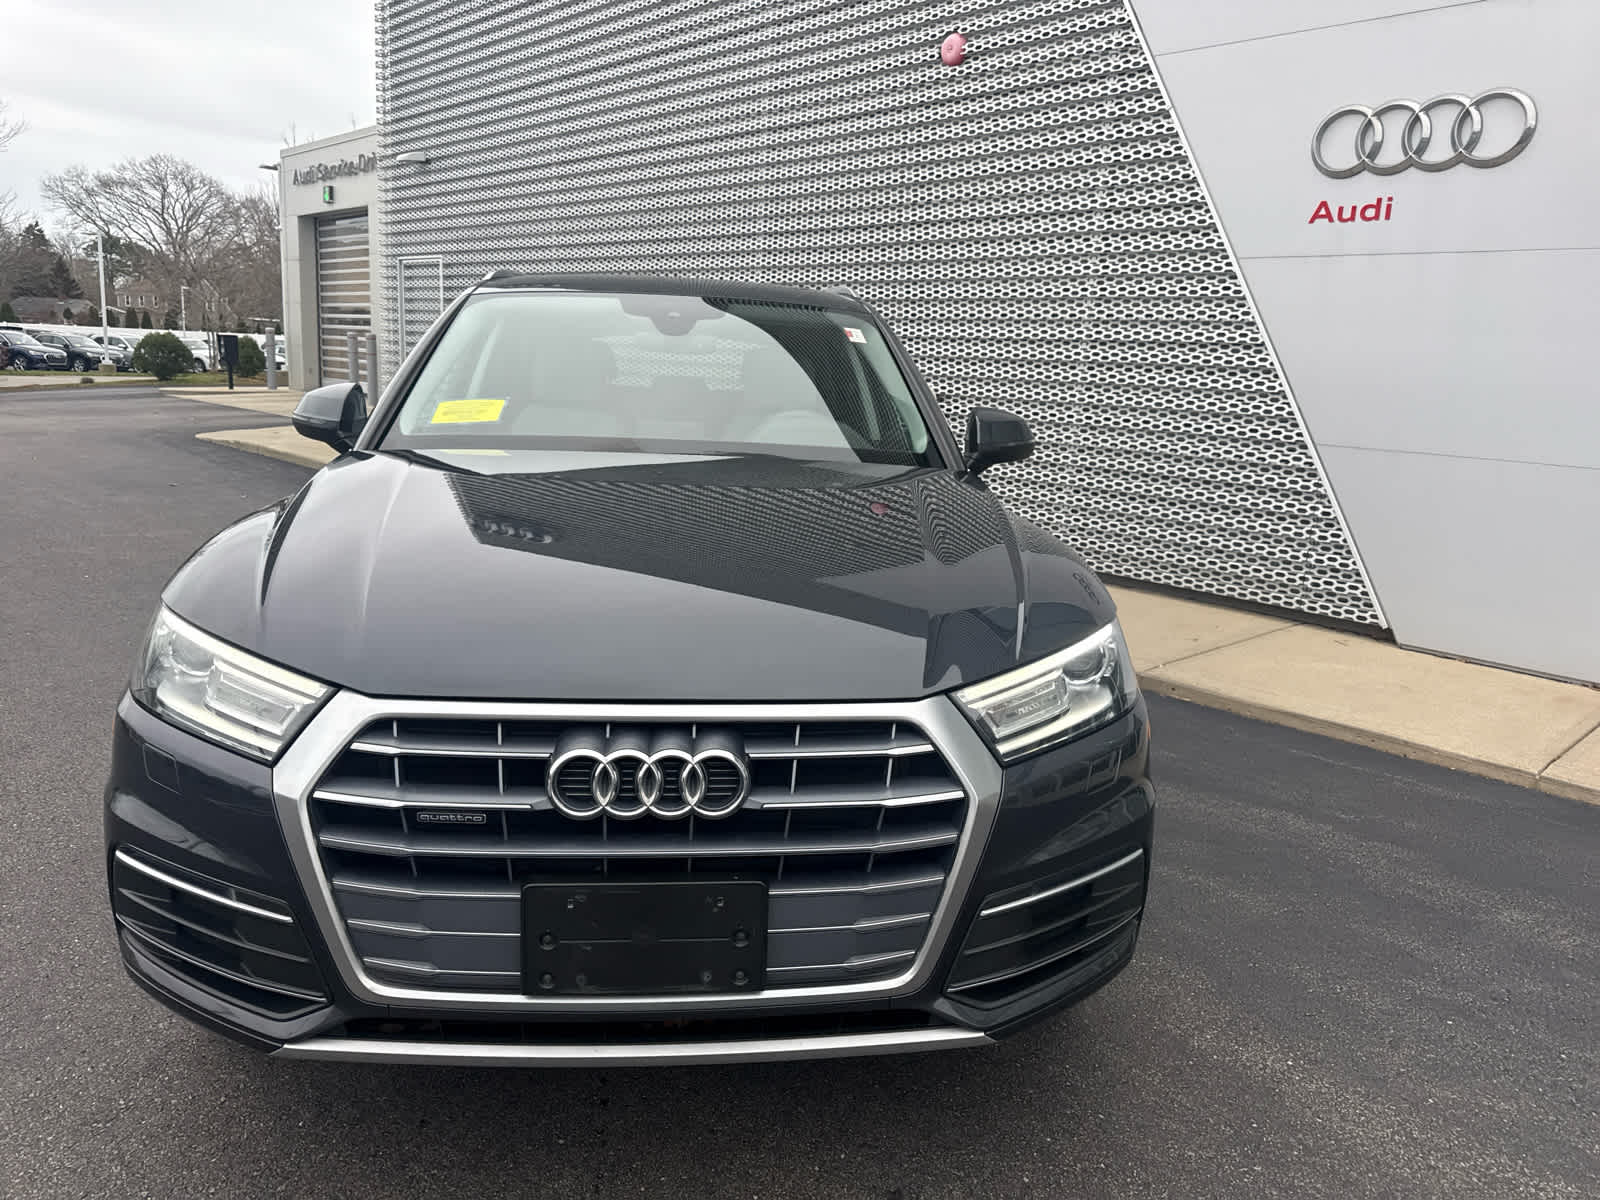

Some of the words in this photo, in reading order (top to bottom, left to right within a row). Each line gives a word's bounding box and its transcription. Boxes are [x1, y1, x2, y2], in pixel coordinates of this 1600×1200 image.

[293, 165, 317, 185] Audi
[317, 159, 357, 182] Service
[1309, 197, 1393, 224] Audi
[419, 813, 483, 823] quattro
